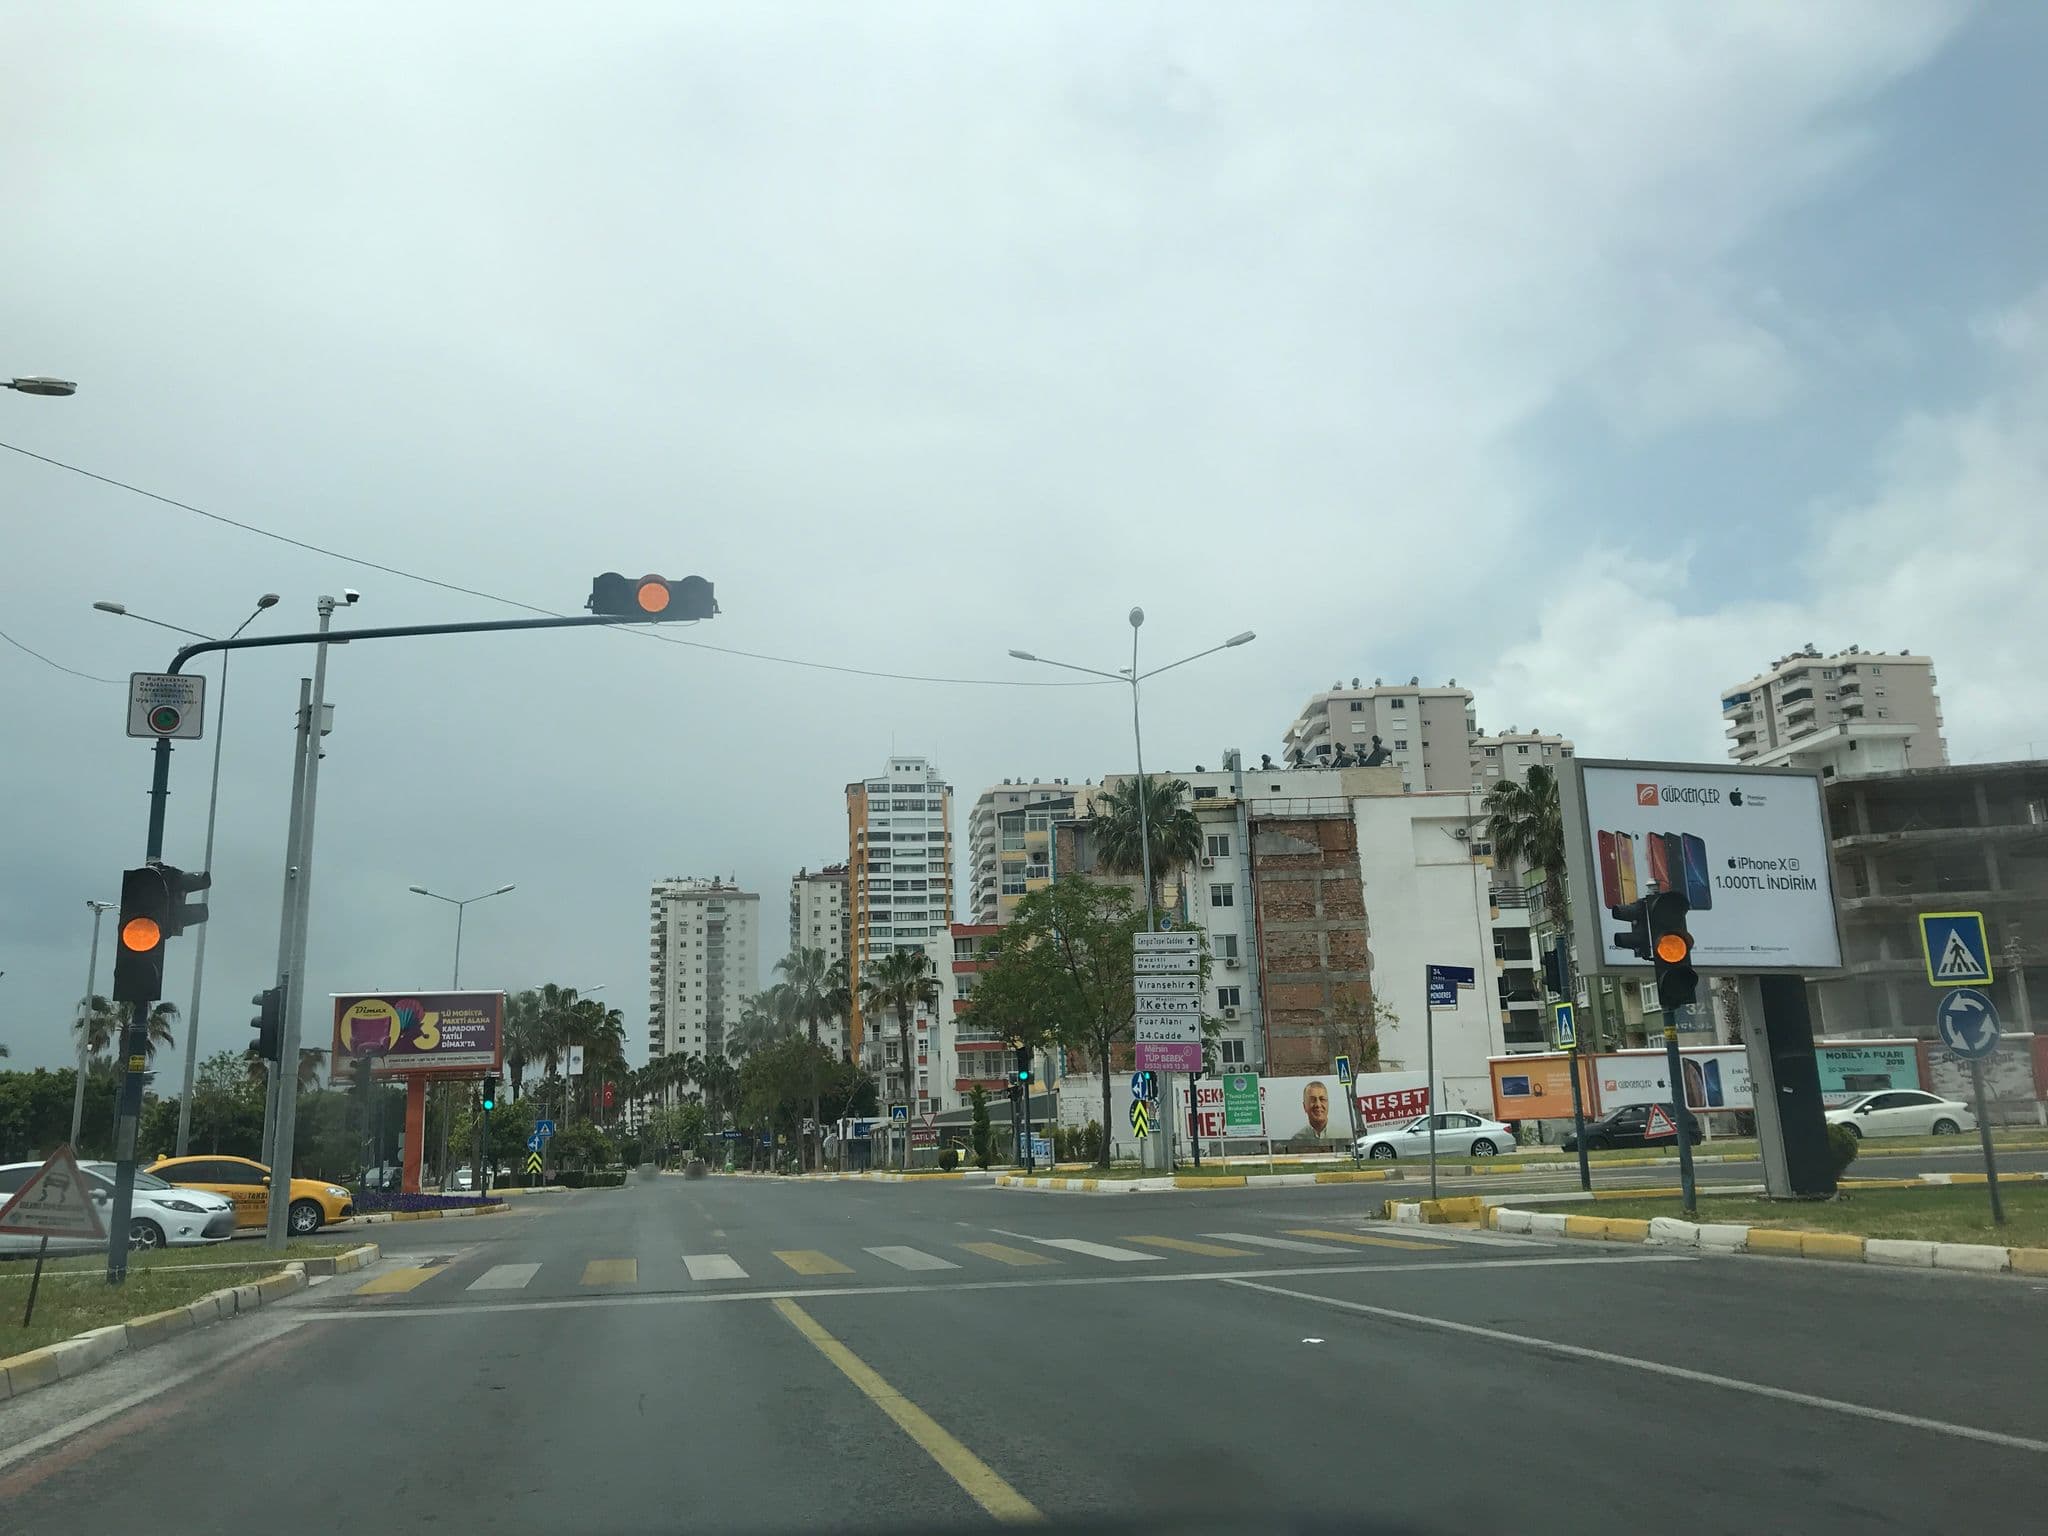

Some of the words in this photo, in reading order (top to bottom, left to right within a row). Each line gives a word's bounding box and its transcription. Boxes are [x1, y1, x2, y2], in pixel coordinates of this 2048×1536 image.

[1661, 785, 1720, 806] GÜRGENÇLER
[1738, 857, 1777, 870] iPhone
[1715, 875, 1765, 889] 1.000TL
[1766, 874, 1817, 890] İNDİRİM
[1138, 980, 1185, 989] Viranşehir
[1146, 1000, 1188, 1009] Ketem
[1138, 1017, 1158, 1025] Fuar
[413, 1011, 441, 1050] 3
[442, 1032, 463, 1040] TATİLİ
[1144, 1045, 1168, 1053] Mersin
[1144, 1053, 1159, 1062] TÜP
[1161, 1054, 1184, 1062] BEBEK
[1826, 1052, 1870, 1060] MOBİLYA
[1873, 1051, 1904, 1059] FUARI
[1361, 1090, 1425, 1111] NEŞET
[1371, 1107, 1422, 1121] TARHAN
